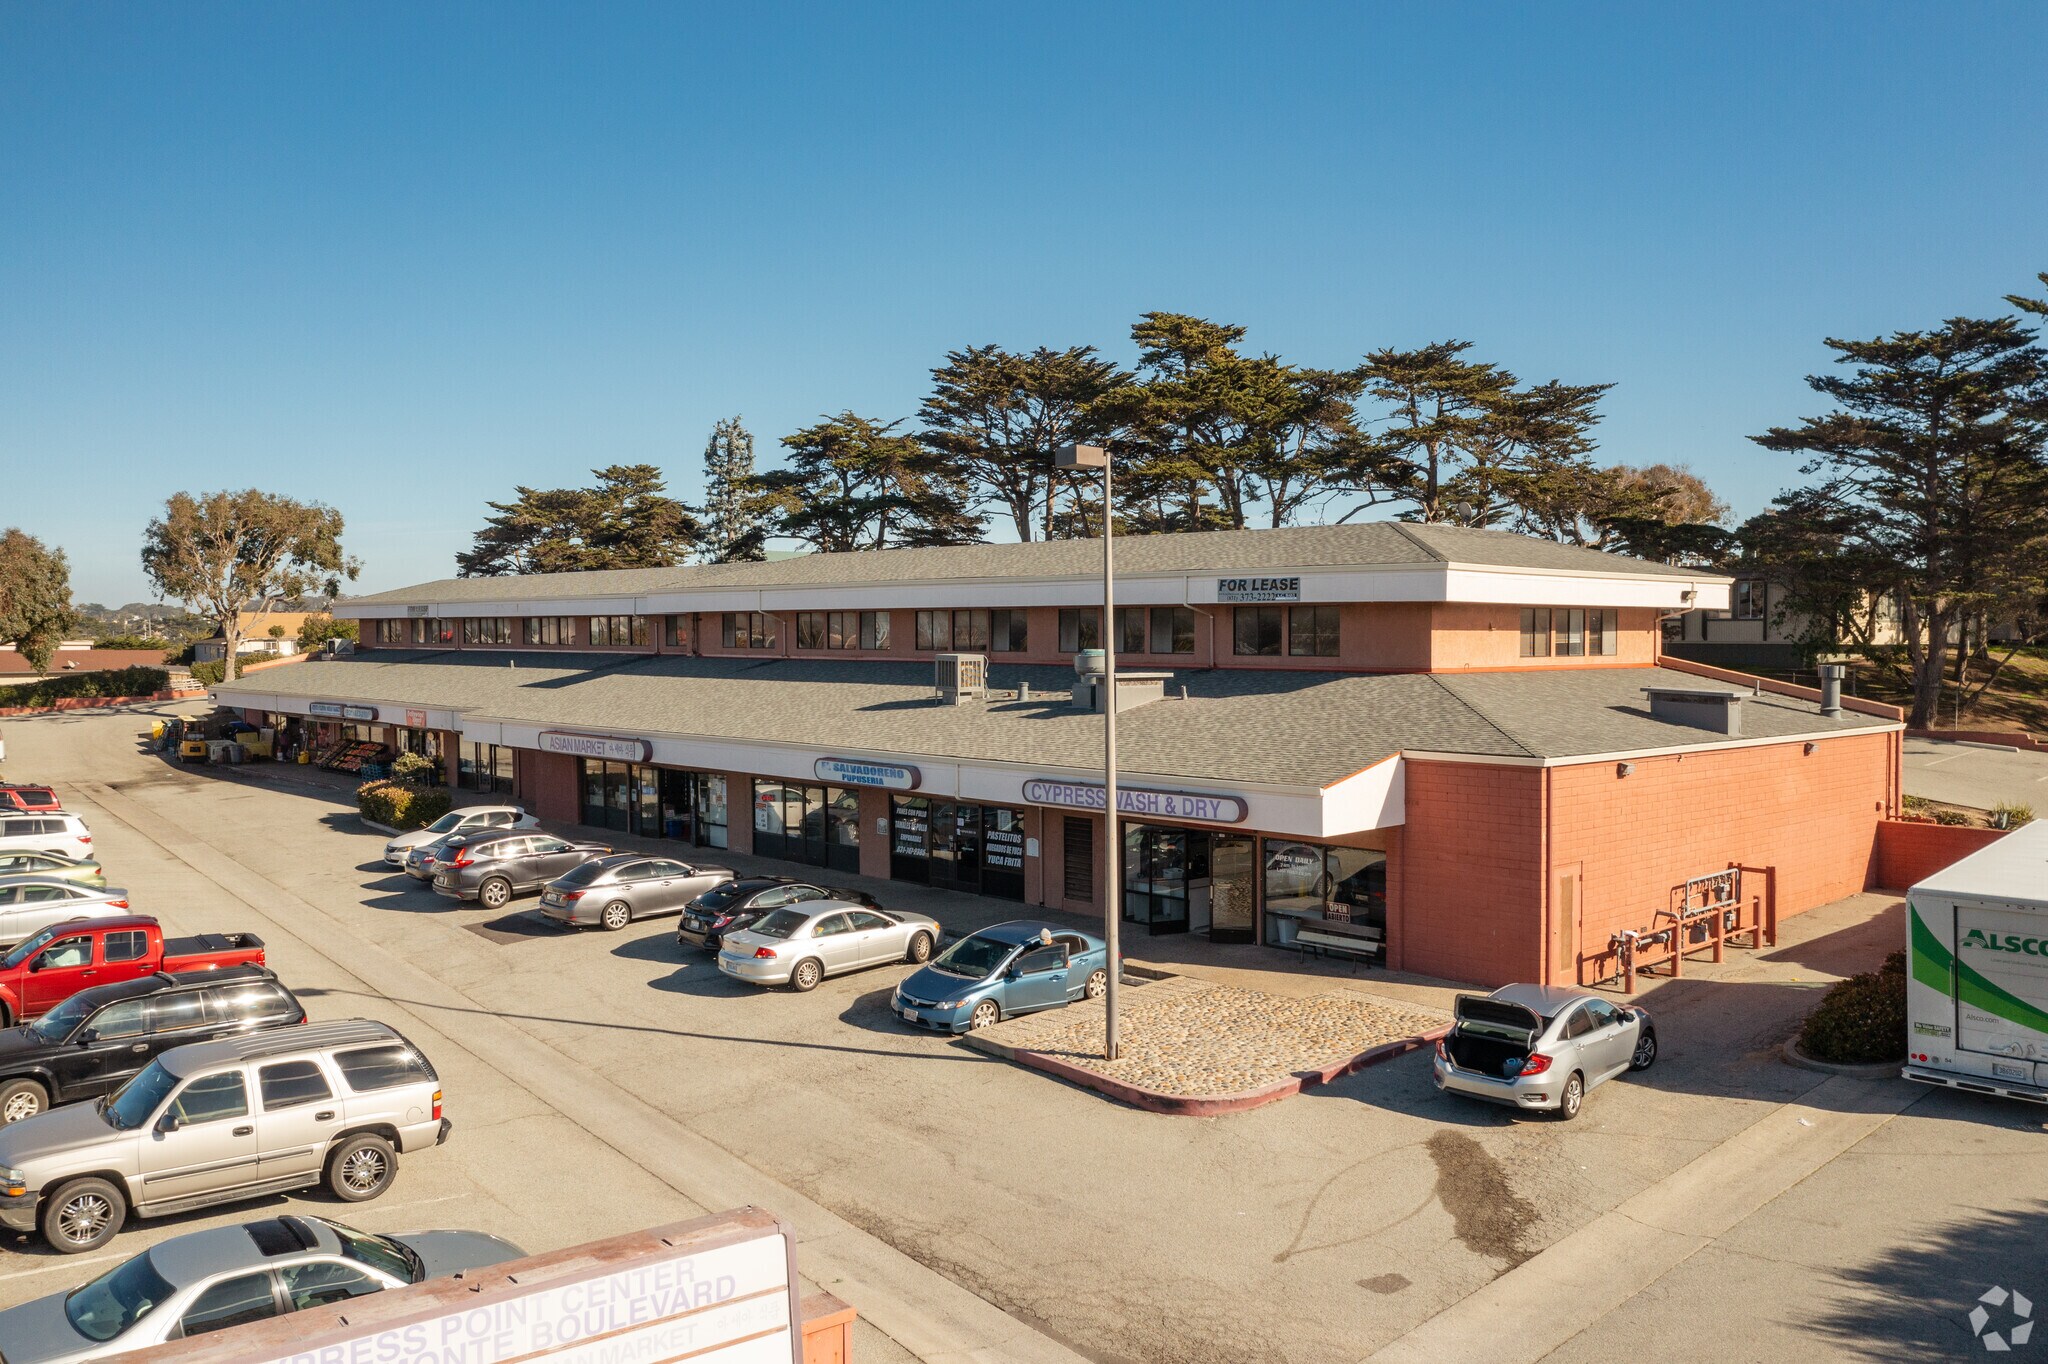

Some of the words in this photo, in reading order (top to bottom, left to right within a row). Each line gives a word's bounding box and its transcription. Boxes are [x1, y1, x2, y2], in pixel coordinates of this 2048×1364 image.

[1219, 579, 1247, 592] FOR
[1252, 577, 1299, 592] LEASE
[1239, 592, 1276, 602] 373-2222
[550, 737, 573, 752] ASIAN
[574, 739, 607, 756] MARKET
[833, 762, 905, 780] SALVADOREÑO
[842, 773, 884, 786] PUPUSERIA
[1031, 783, 1106, 808] CYPRESS
[1164, 796, 1177, 815] &
[1182, 797, 1221, 819] DRY
[987, 830, 1022, 844] PASTELITOS
[987, 854, 1004, 866] YUCA
[1004, 856, 1022, 868] FRITA
[1275, 854, 1293, 863] OPEN
[1294, 856, 1314, 865] DAILY
[1328, 903, 1348, 914] OPEN
[1328, 913, 1350, 923] ABIERTO
[1965, 1012, 2000, 1025] Alsco.com
[441, 1293, 551, 1347] POINT
[561, 1258, 695, 1314] CENTER
[398, 1330, 515, 1364] ONTE
[531, 1274, 736, 1351] BOULEVARD
[599, 1323, 699, 1364] MARKET
